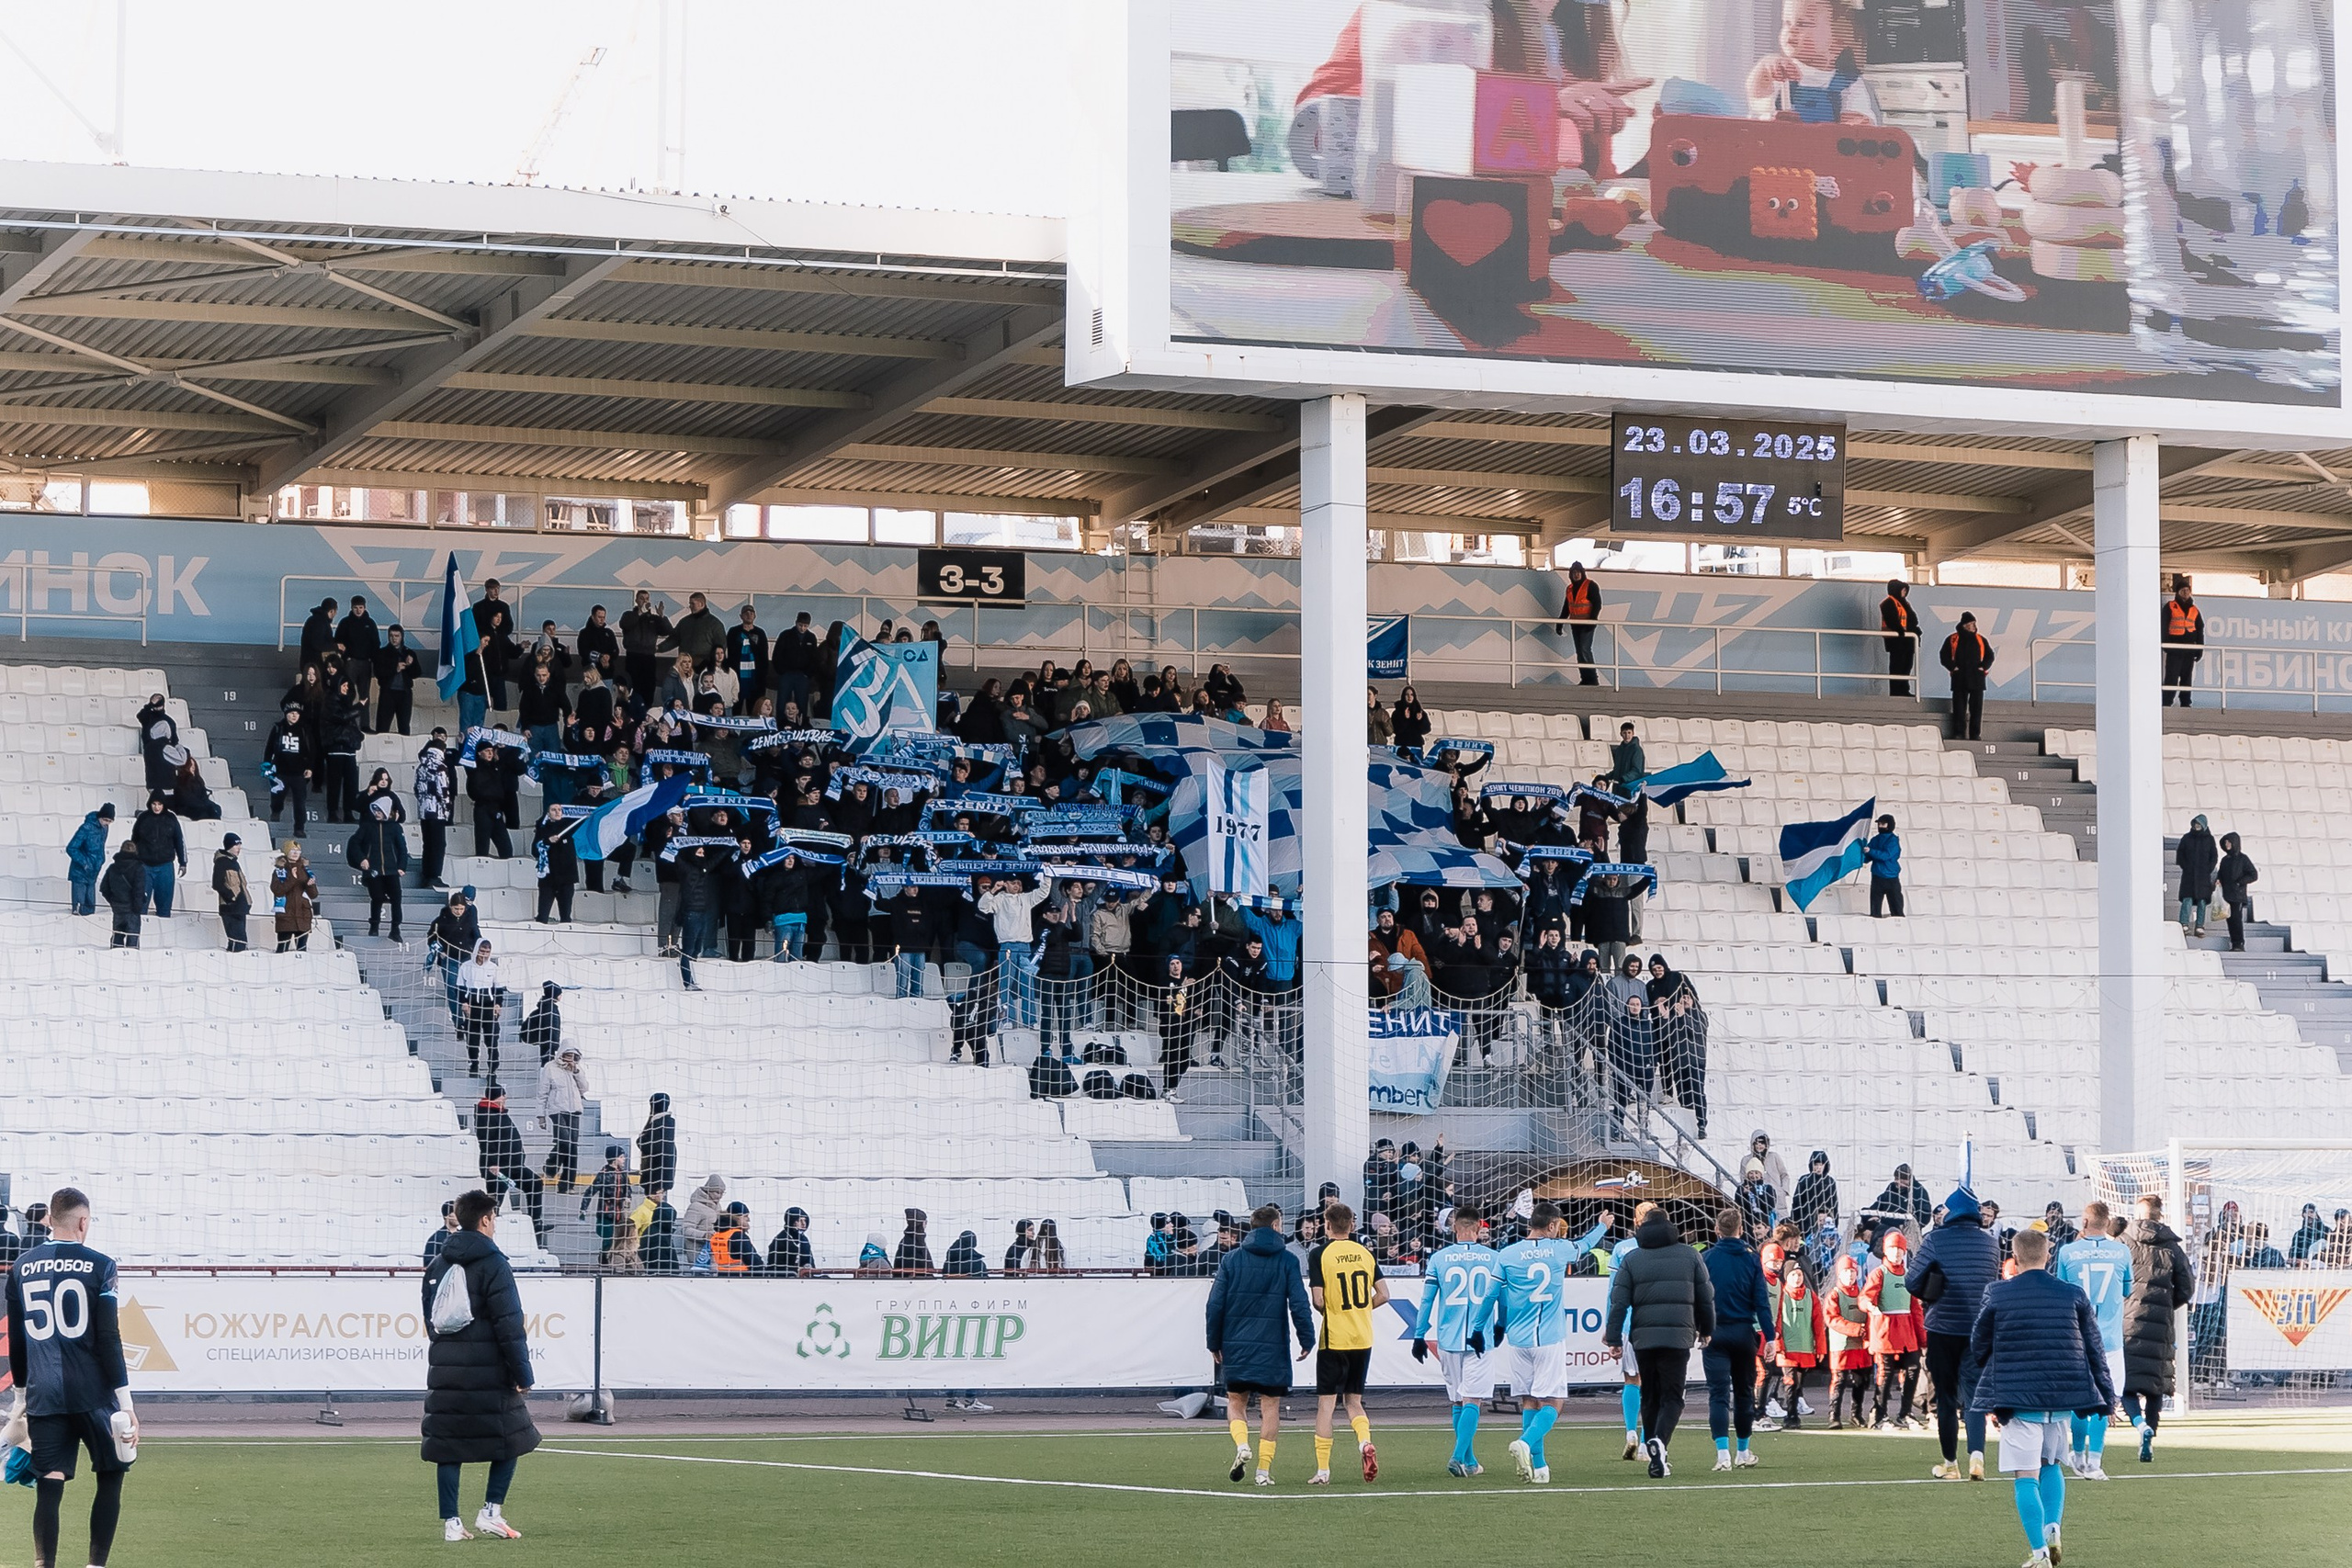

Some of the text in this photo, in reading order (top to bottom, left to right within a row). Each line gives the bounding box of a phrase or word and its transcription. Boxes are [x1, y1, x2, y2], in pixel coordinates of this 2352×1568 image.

[1623, 425, 1837, 461] 23.03.2025
[1620, 477, 1776, 525] 16:57
[939, 564, 1004, 594] 3-3
[2206, 615, 2320, 641] ОЛЬНЫЙ
[1375, 659, 1405, 669] ЗЕНИТ
[223, 691, 237, 701] 19
[244, 721, 256, 730] 18
[282, 736, 300, 750] 45
[752, 728, 835, 750] ZENIT ULTRAS
[1985, 745, 1996, 754] 19
[2018, 772, 2029, 781] 18
[1486, 784, 1507, 793] ЗЕНИТ
[1509, 784, 1545, 795] ЧЕМПИОН
[954, 800, 1002, 812] ZENIT
[2052, 797, 2063, 807] 17
[306, 811, 319, 821] 15
[1216, 816, 1261, 842] 1977
[328, 844, 342, 854] 14
[1541, 848, 1579, 856] ЗЕНИТ
[423, 976, 435, 987] 10
[2304, 1002, 2315, 1012] 10
[1368, 1010, 1452, 1033] ЕНИТ
[1369, 1085, 1426, 1107] mber
[526, 1121, 534, 1132] 6
[1444, 1253, 1491, 1263] ПОМЕРКО
[1520, 1248, 1555, 1261] ХОЗИН
[21, 1259, 94, 1277] СУГРОБОВ
[1445, 1266, 1491, 1305] 20
[1527, 1262, 1554, 1303] 2
[2077, 1263, 2115, 1303] 17
[1337, 1270, 1369, 1311] 10
[22, 1279, 89, 1341] 50
[876, 1300, 1028, 1311] ГРУППА ФИРМ
[185, 1313, 566, 1339] ЮЖУРАЛСТРОИС
[876, 1313, 1027, 1360] ВИПР
[206, 1347, 424, 1362] СПЕЦИАЛИЗИРОВАННЫЙ
